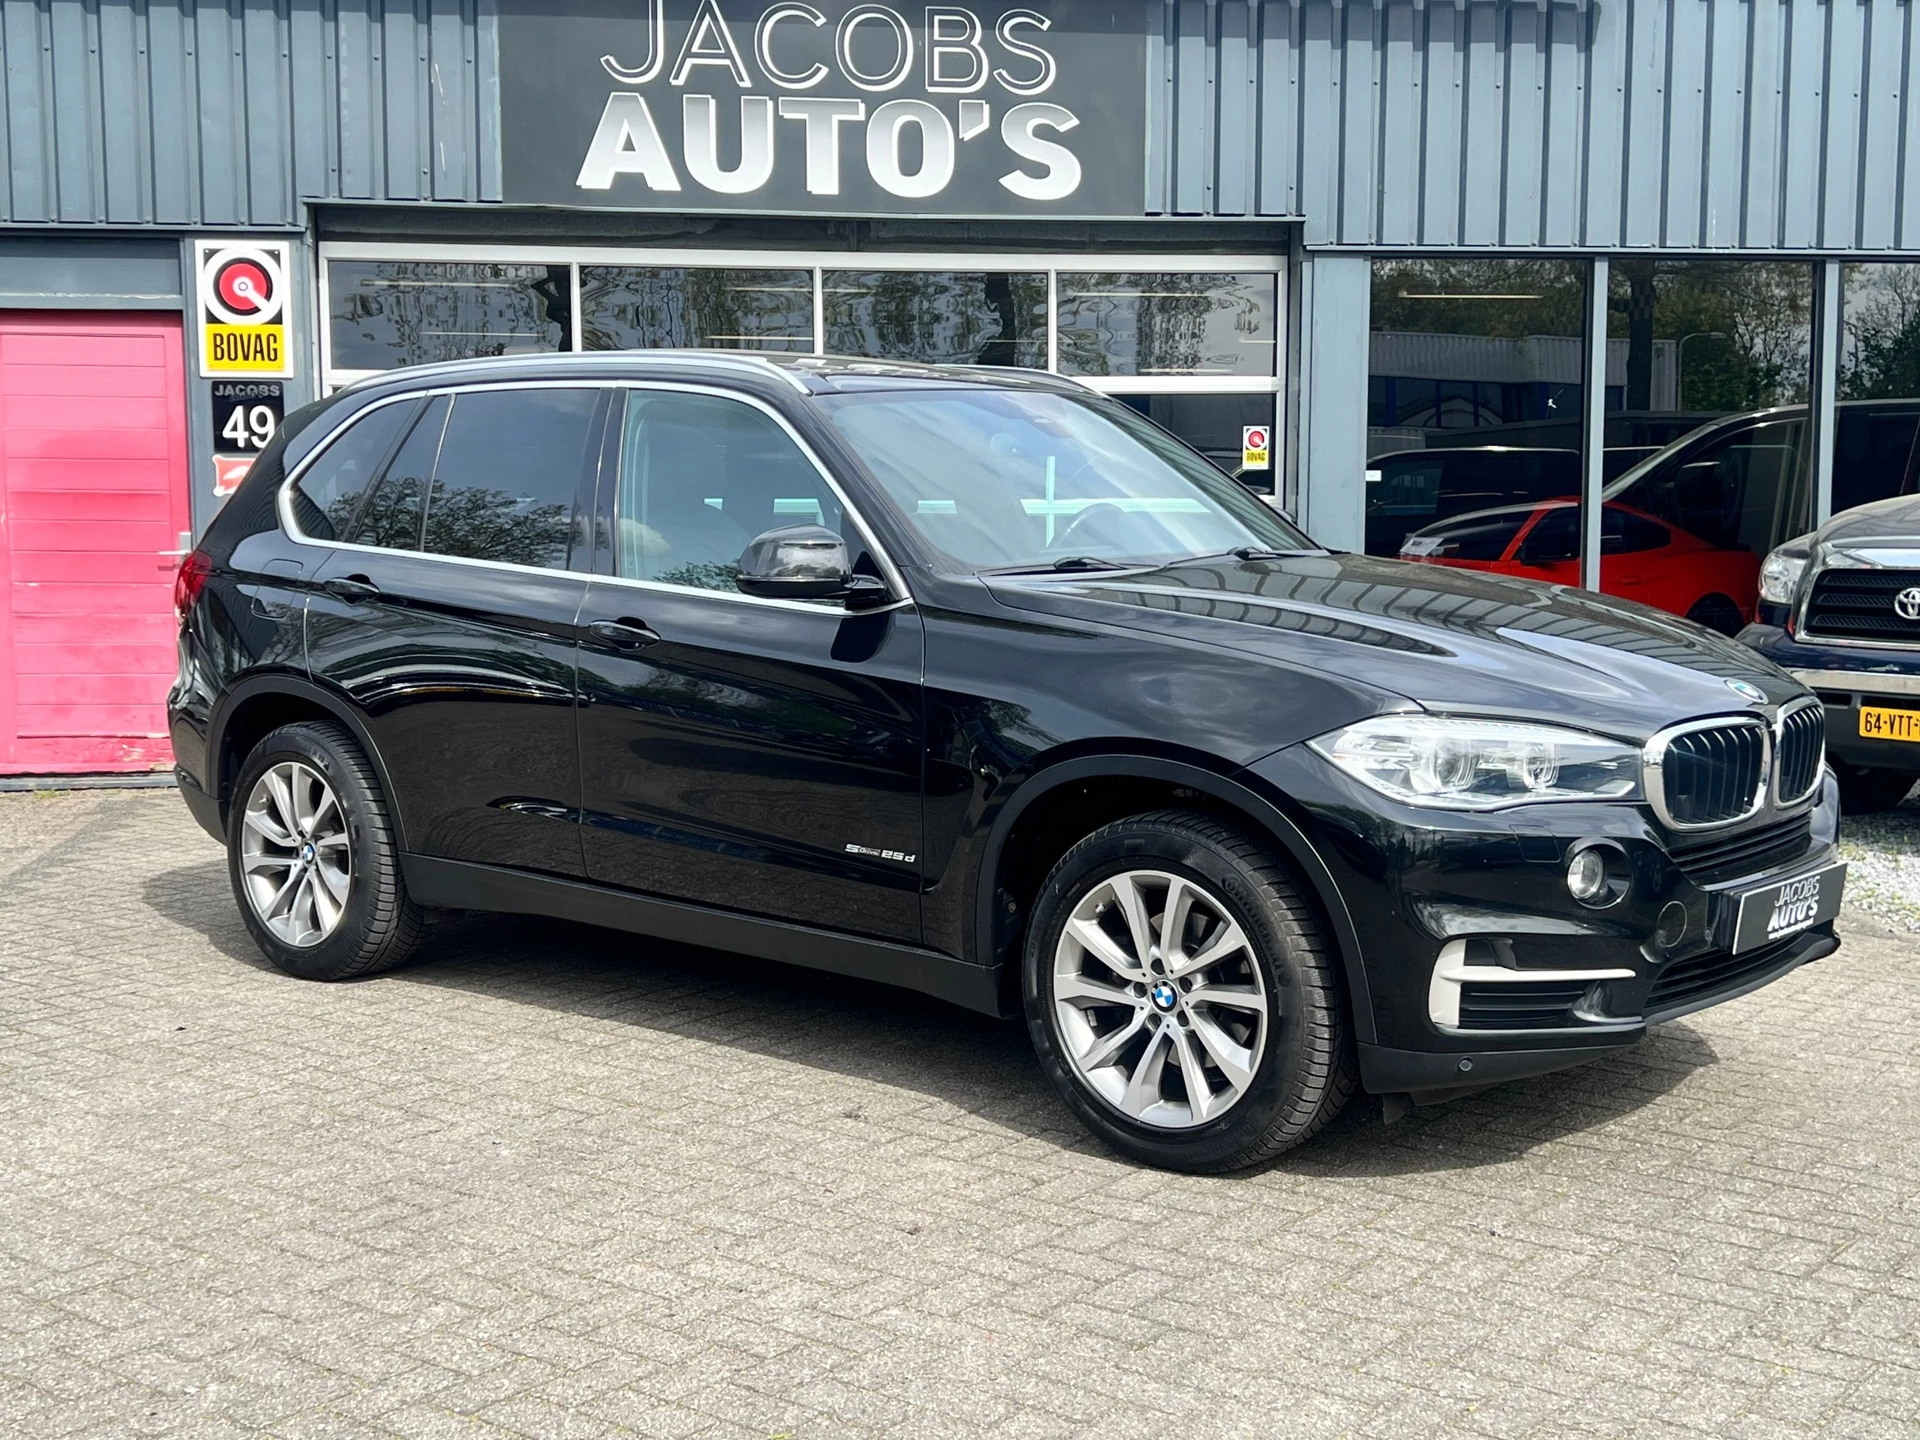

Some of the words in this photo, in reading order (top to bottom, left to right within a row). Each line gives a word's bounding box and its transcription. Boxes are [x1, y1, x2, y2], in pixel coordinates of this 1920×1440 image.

[600, 0, 1057, 95] JACOBS
[575, 92, 1082, 200] AUTO'S
[213, 332, 278, 362] BOVAG
[214, 384, 280, 397] JACOBS
[222, 405, 276, 449] 49
[1246, 452, 1266, 462] BOVAG
[1865, 711, 1920, 737] 64-VTT-
[1774, 876, 1820, 907] JACOBS
